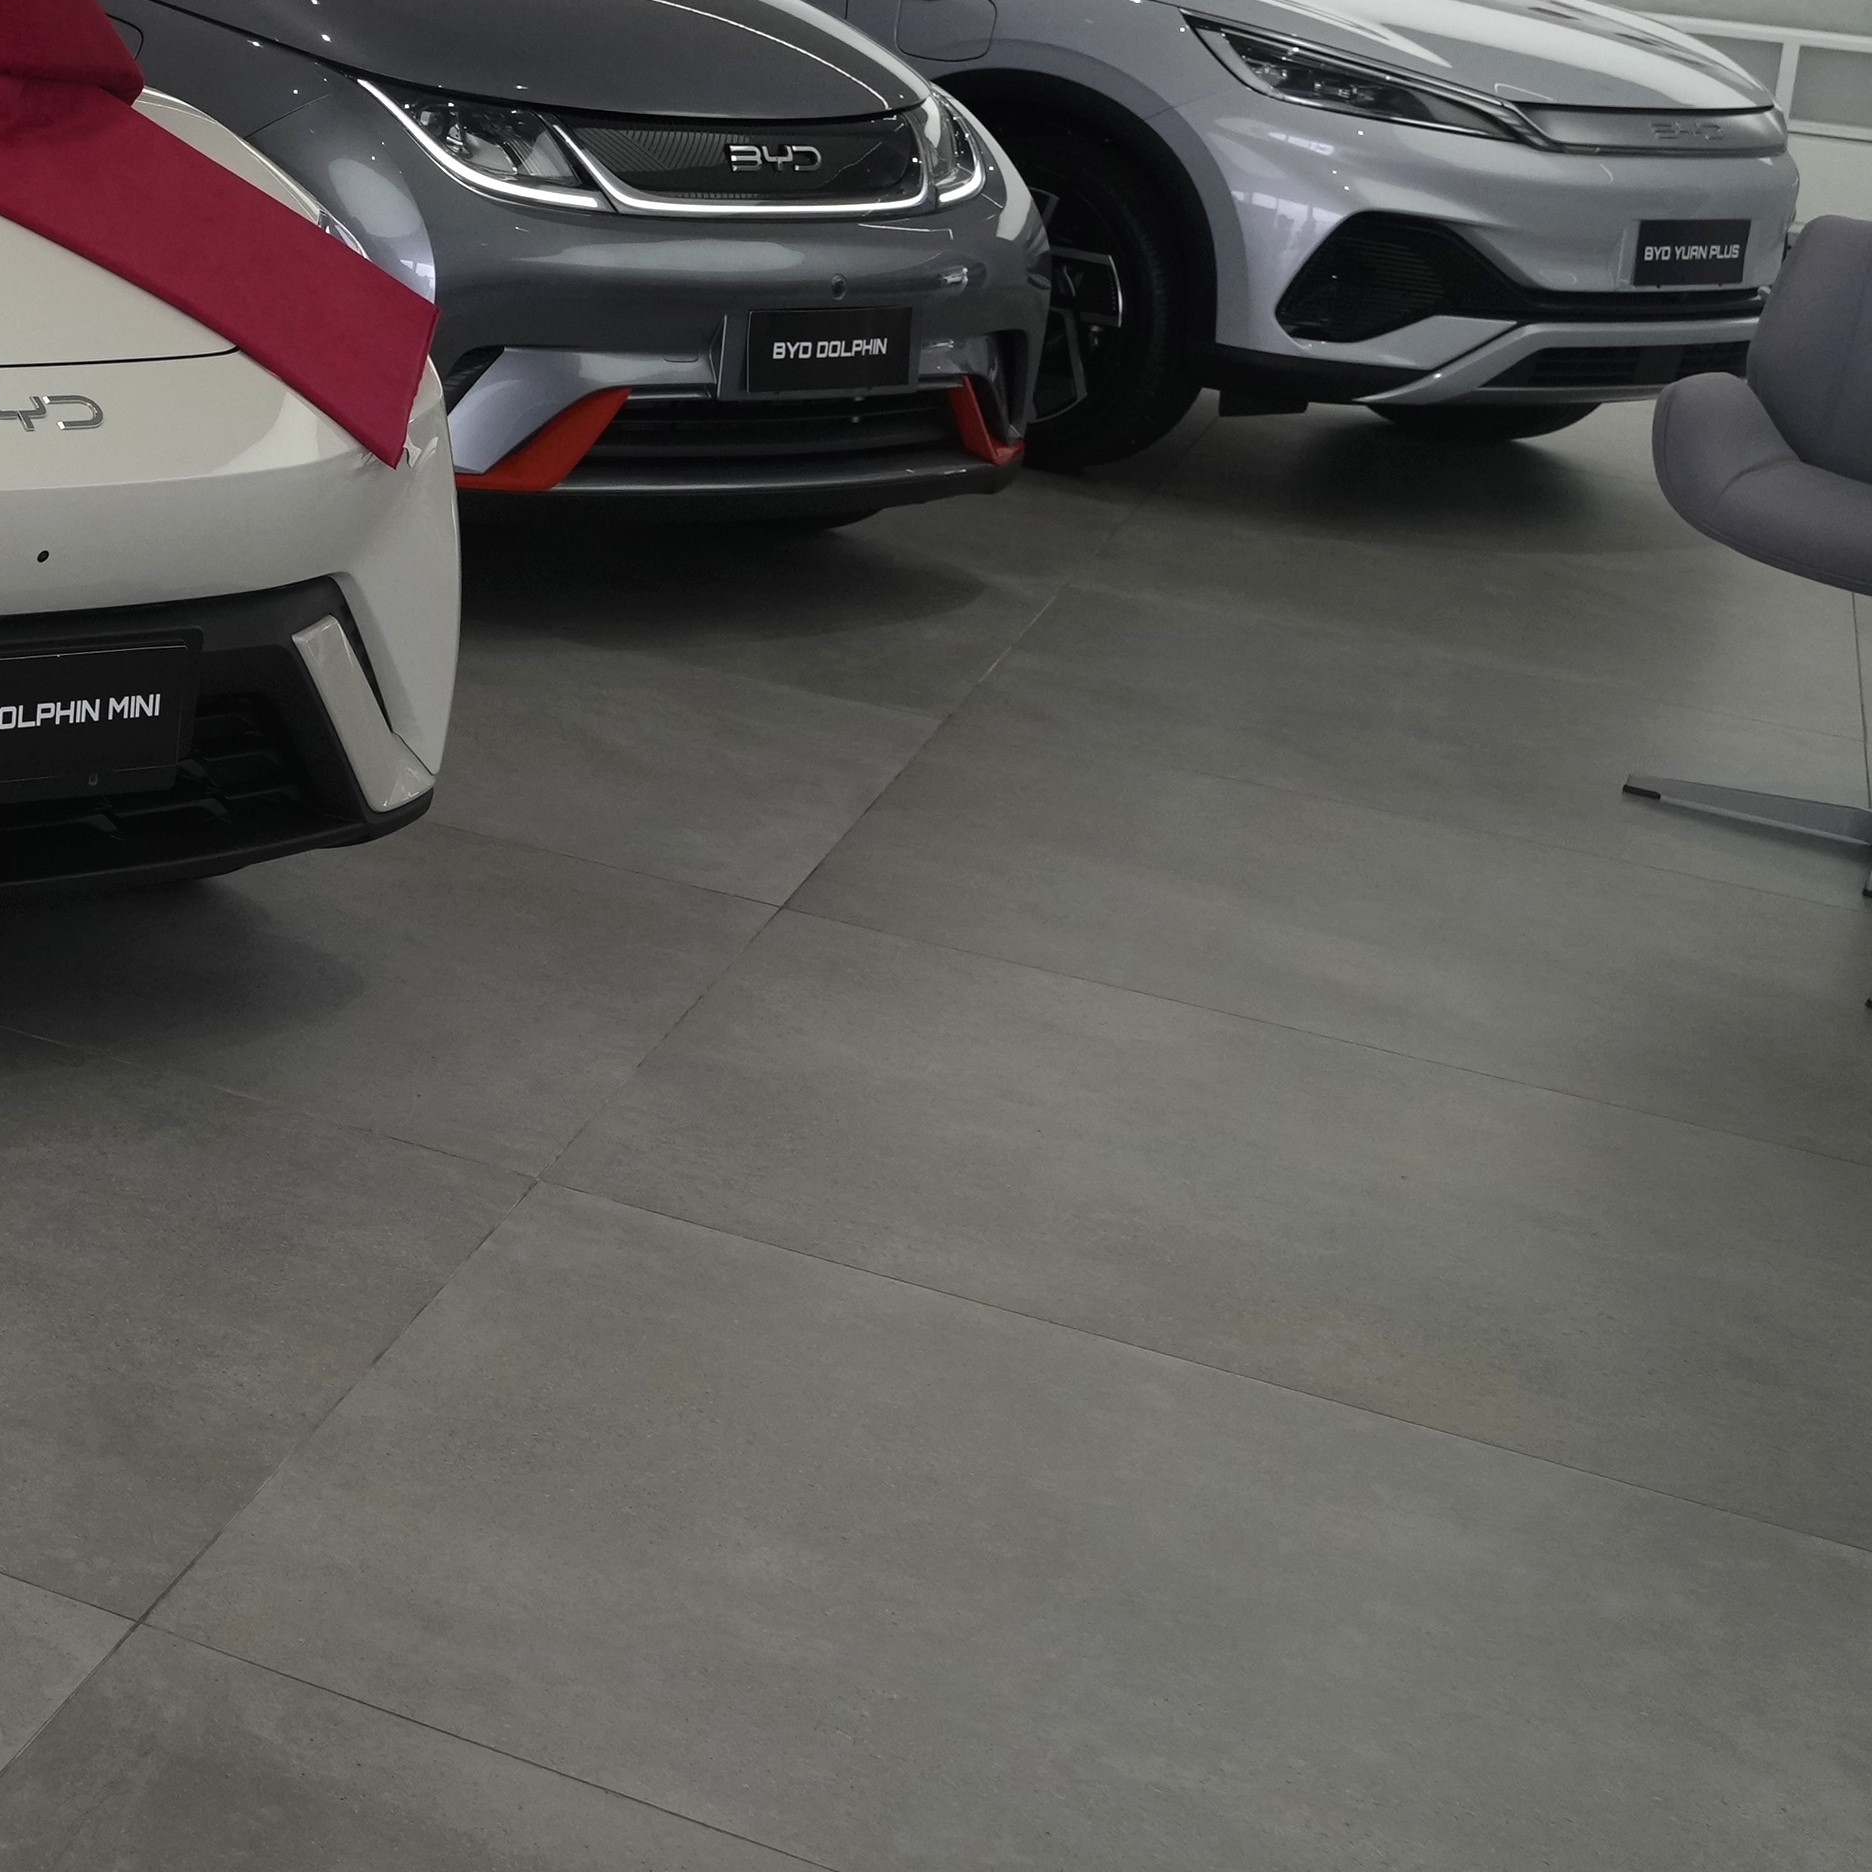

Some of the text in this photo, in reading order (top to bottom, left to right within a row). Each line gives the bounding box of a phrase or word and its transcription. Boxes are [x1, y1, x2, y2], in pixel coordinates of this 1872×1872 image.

[728, 144, 823, 172] BYD
[1644, 244, 1740, 261] BYD YUAN PLUS
[772, 337, 888, 360] BYD DOLPHIN
[107, 693, 161, 721] MINI
